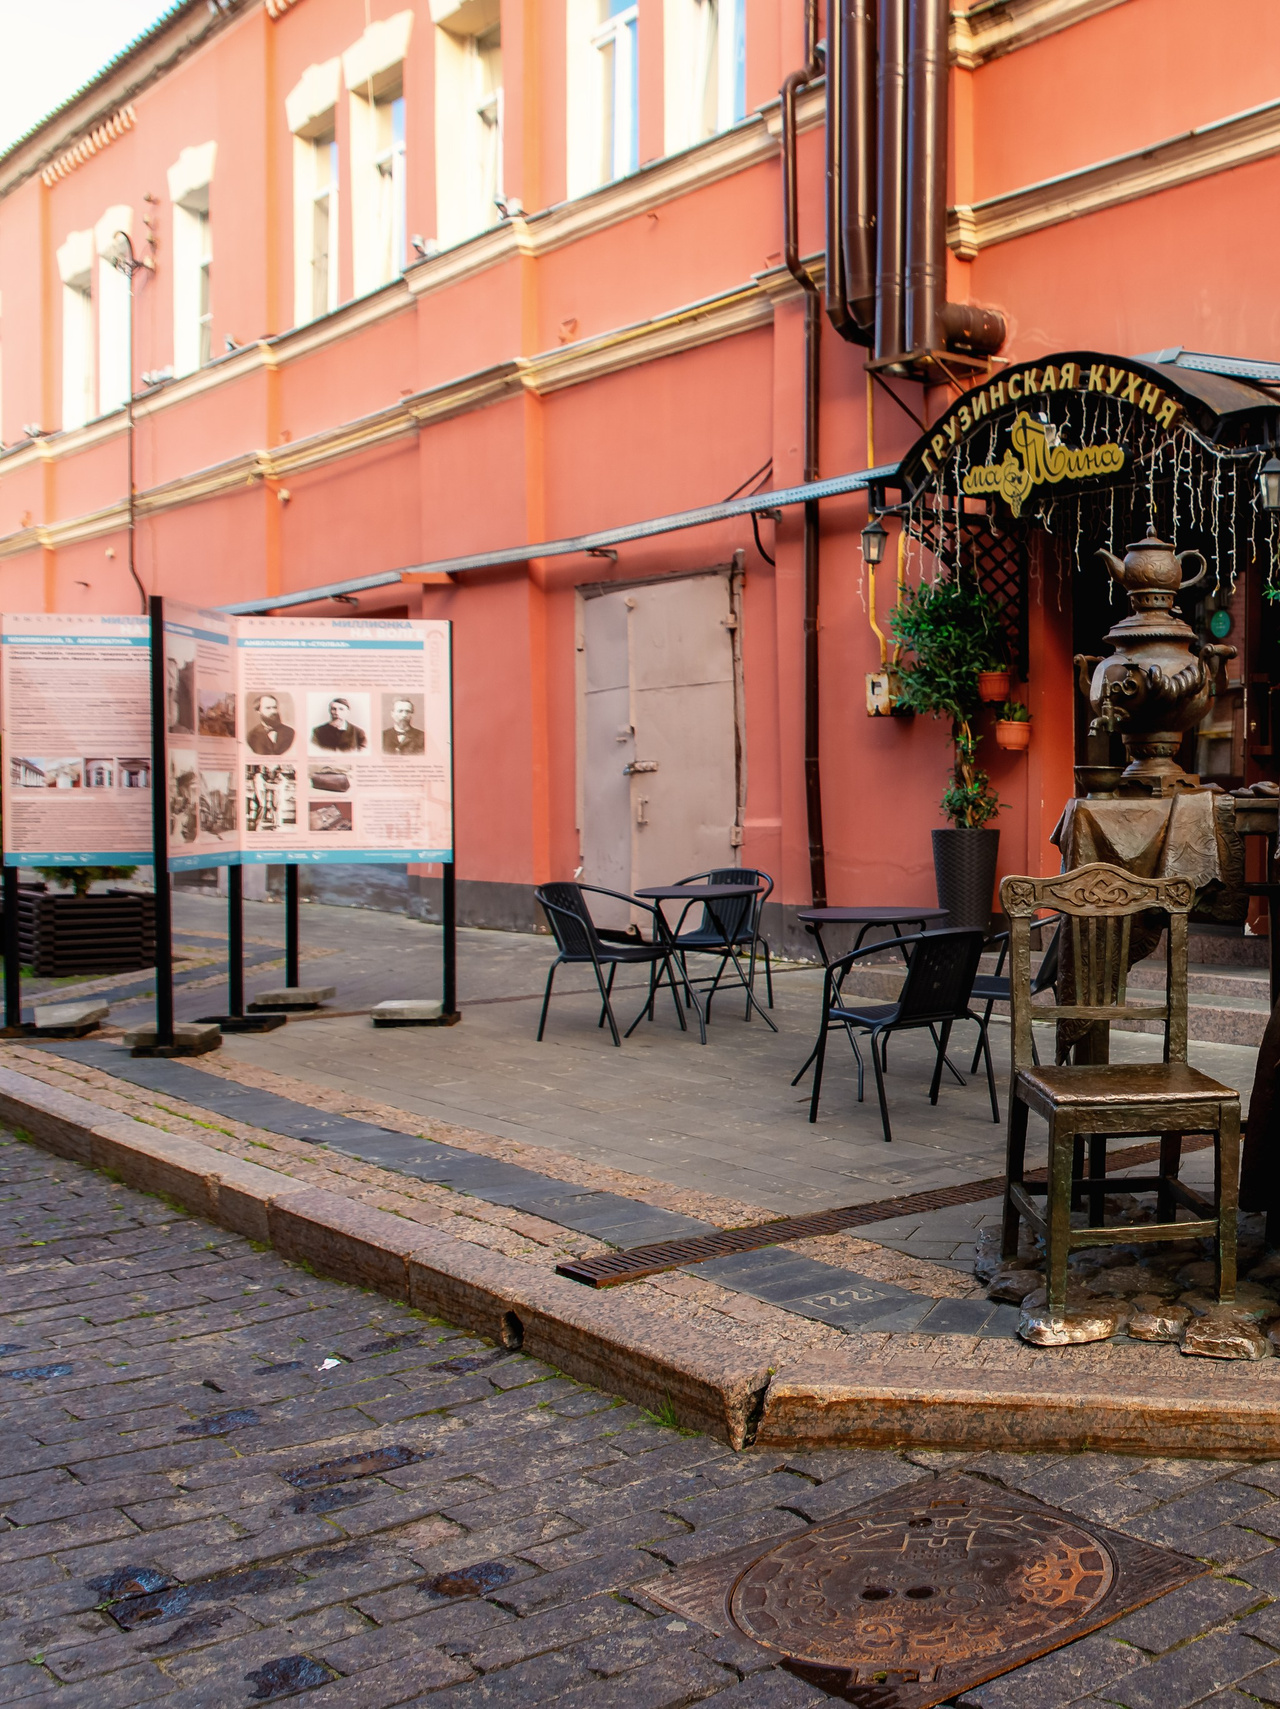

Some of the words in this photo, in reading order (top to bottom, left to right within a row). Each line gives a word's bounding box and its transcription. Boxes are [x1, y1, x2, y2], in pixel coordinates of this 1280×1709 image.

[921, 363, 1076, 474] ГРУЗИНСКАЯ
[1088, 364, 1178, 430] КУХНЯ
[101, 616, 151, 625] МИЛЛИ
[332, 620, 413, 629] МИЛЛИОНКА
[350, 628, 373, 638] НА
[376, 628, 426, 638] ВОЛГЕ
[802, 1286, 888, 1310] 1221
